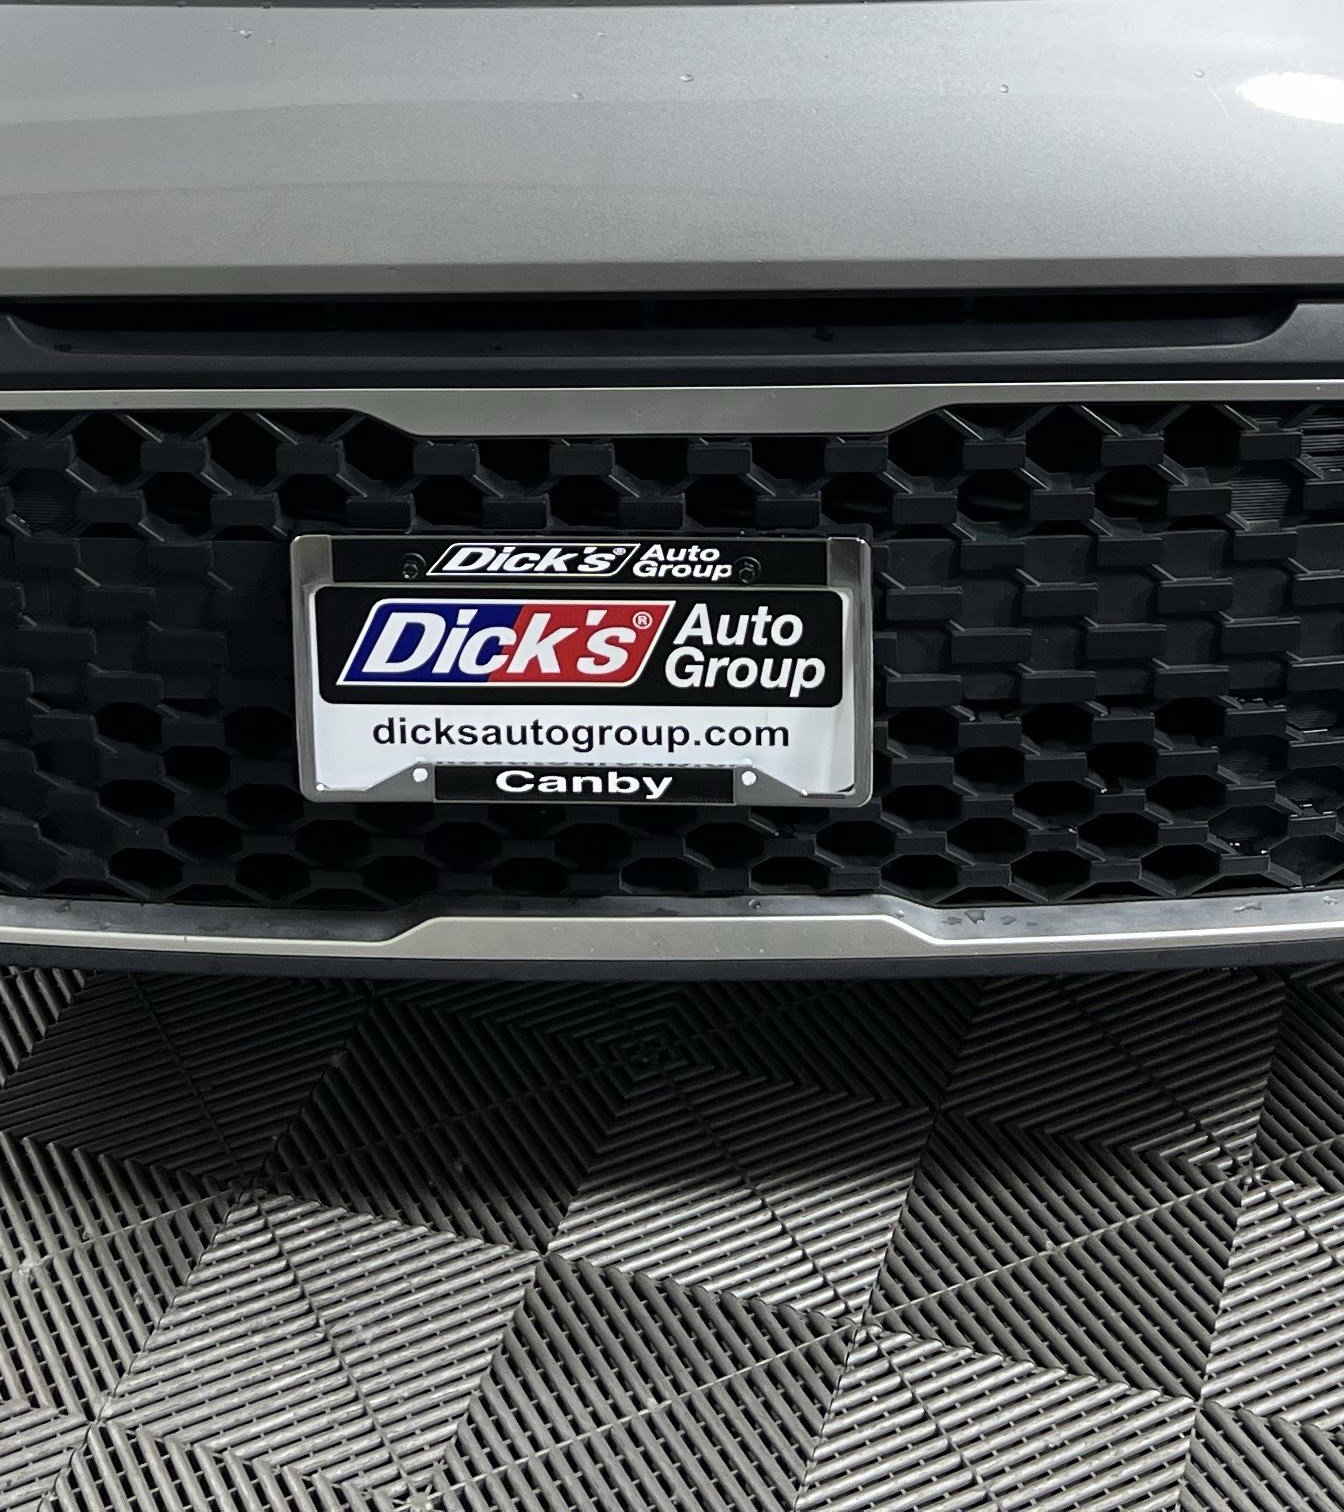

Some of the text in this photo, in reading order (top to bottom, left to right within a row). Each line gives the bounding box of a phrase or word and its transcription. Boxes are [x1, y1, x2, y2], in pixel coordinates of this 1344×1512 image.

[640, 543, 720, 563] Auto
[633, 561, 733, 582] Group
[672, 603, 804, 647] Auto
[664, 648, 826, 699] Group
[372, 717, 790, 753] dicksautogroup.com
[495, 770, 674, 800] Canby
